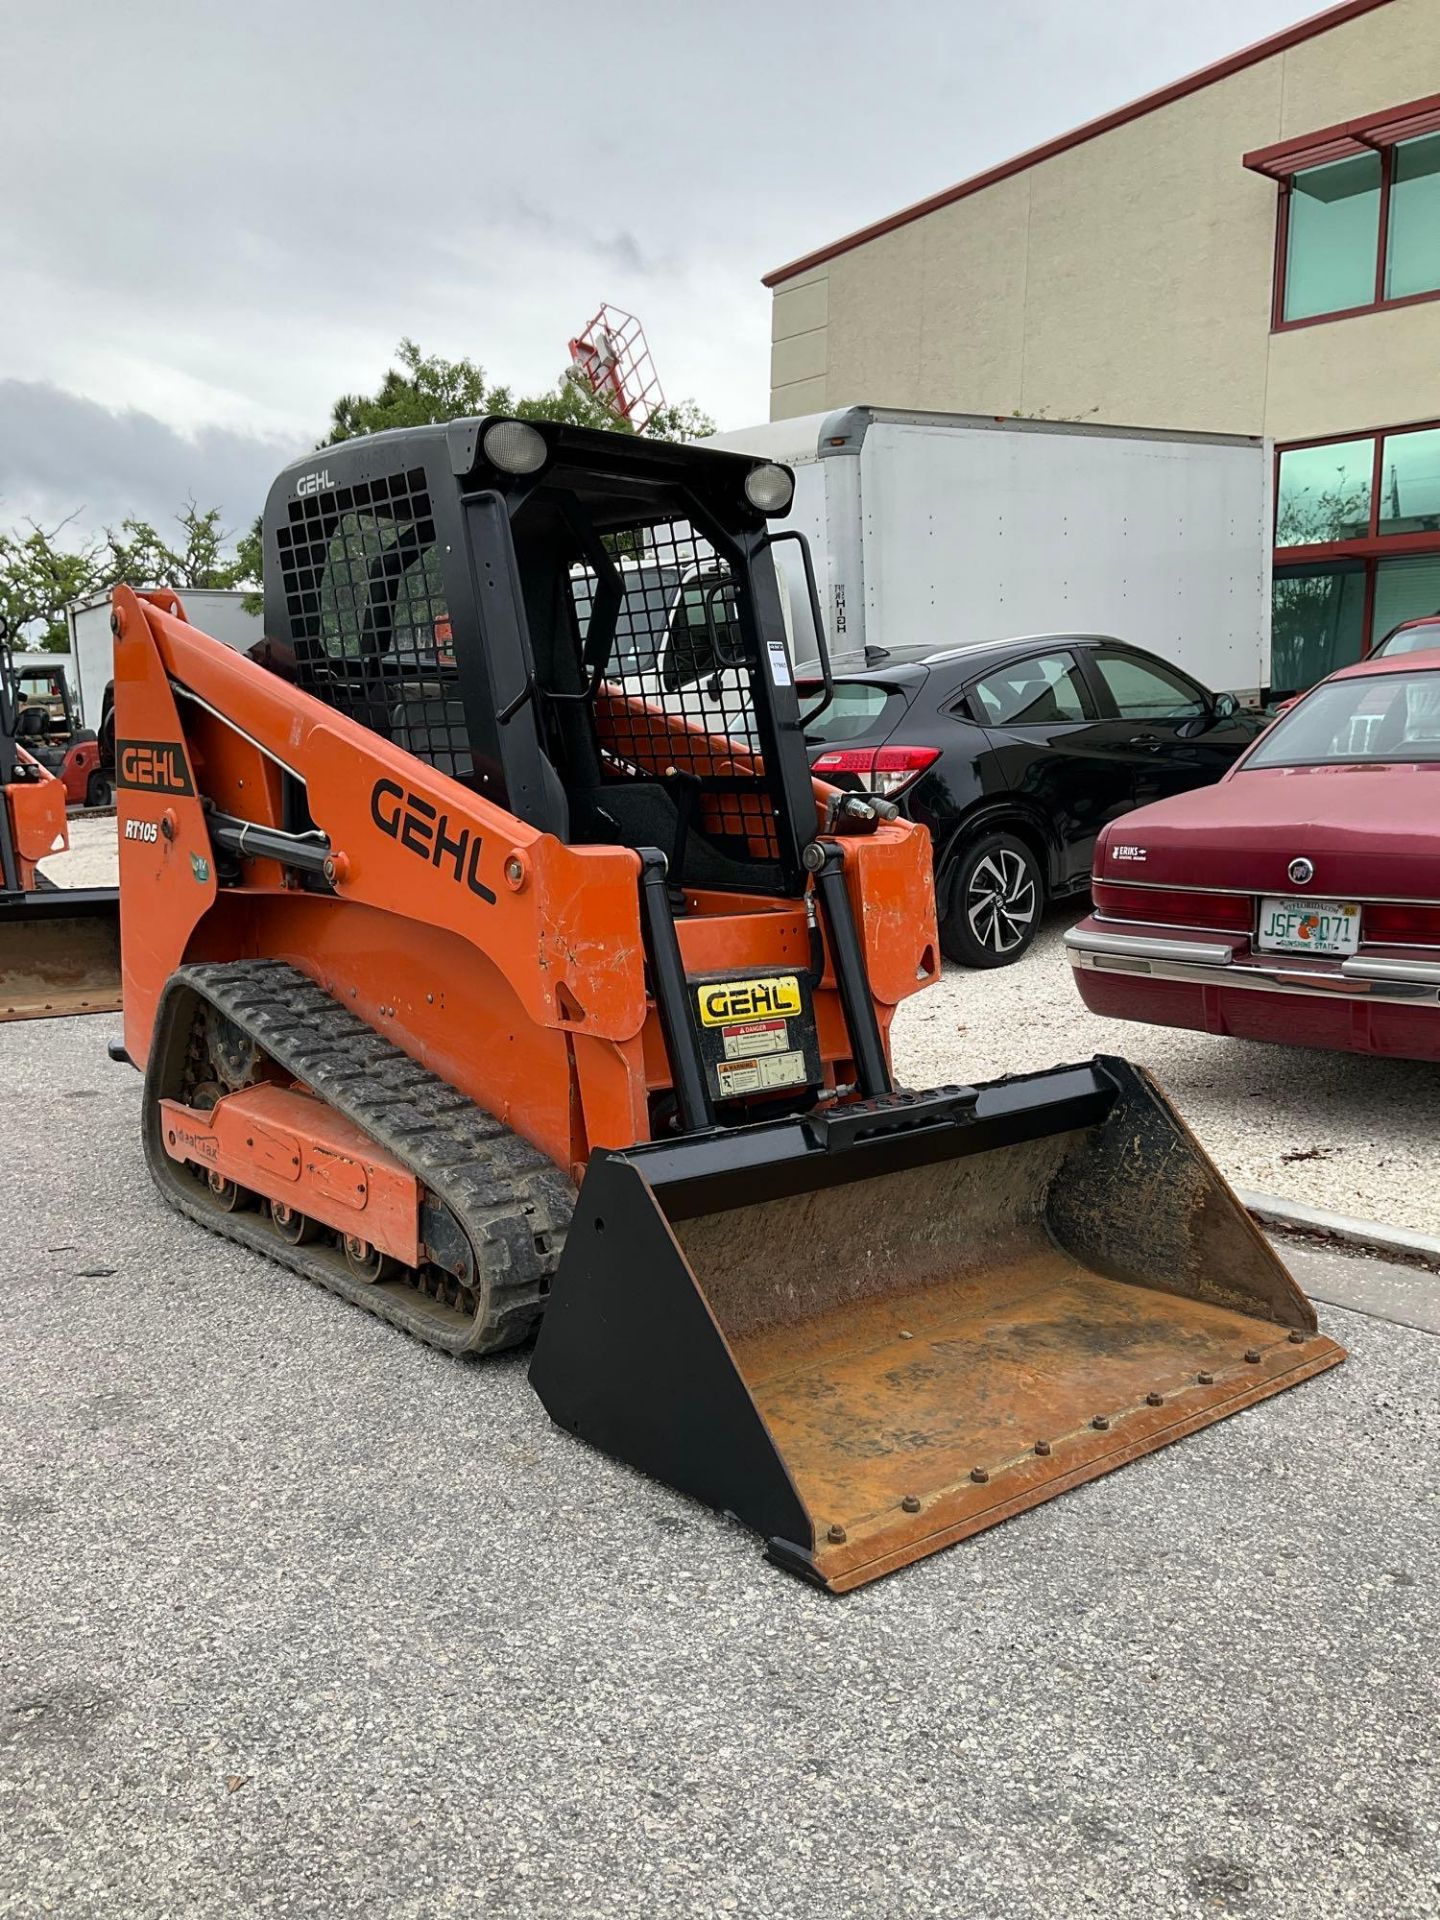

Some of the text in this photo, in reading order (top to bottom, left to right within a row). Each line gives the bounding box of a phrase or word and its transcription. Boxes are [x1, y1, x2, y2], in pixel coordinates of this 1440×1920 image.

[296, 469, 335, 497] GEHL
[122, 747, 185, 788] GEHL
[125, 819, 158, 843] RT105
[371, 778, 497, 905] GEHL
[1264, 913, 1298, 938] JSF
[1280, 940, 1335, 951] SUNSHINE STATE
[706, 983, 793, 1018] GEHL
[745, 1025, 767, 1033] DANGER
[729, 1062, 754, 1072] WARNING
